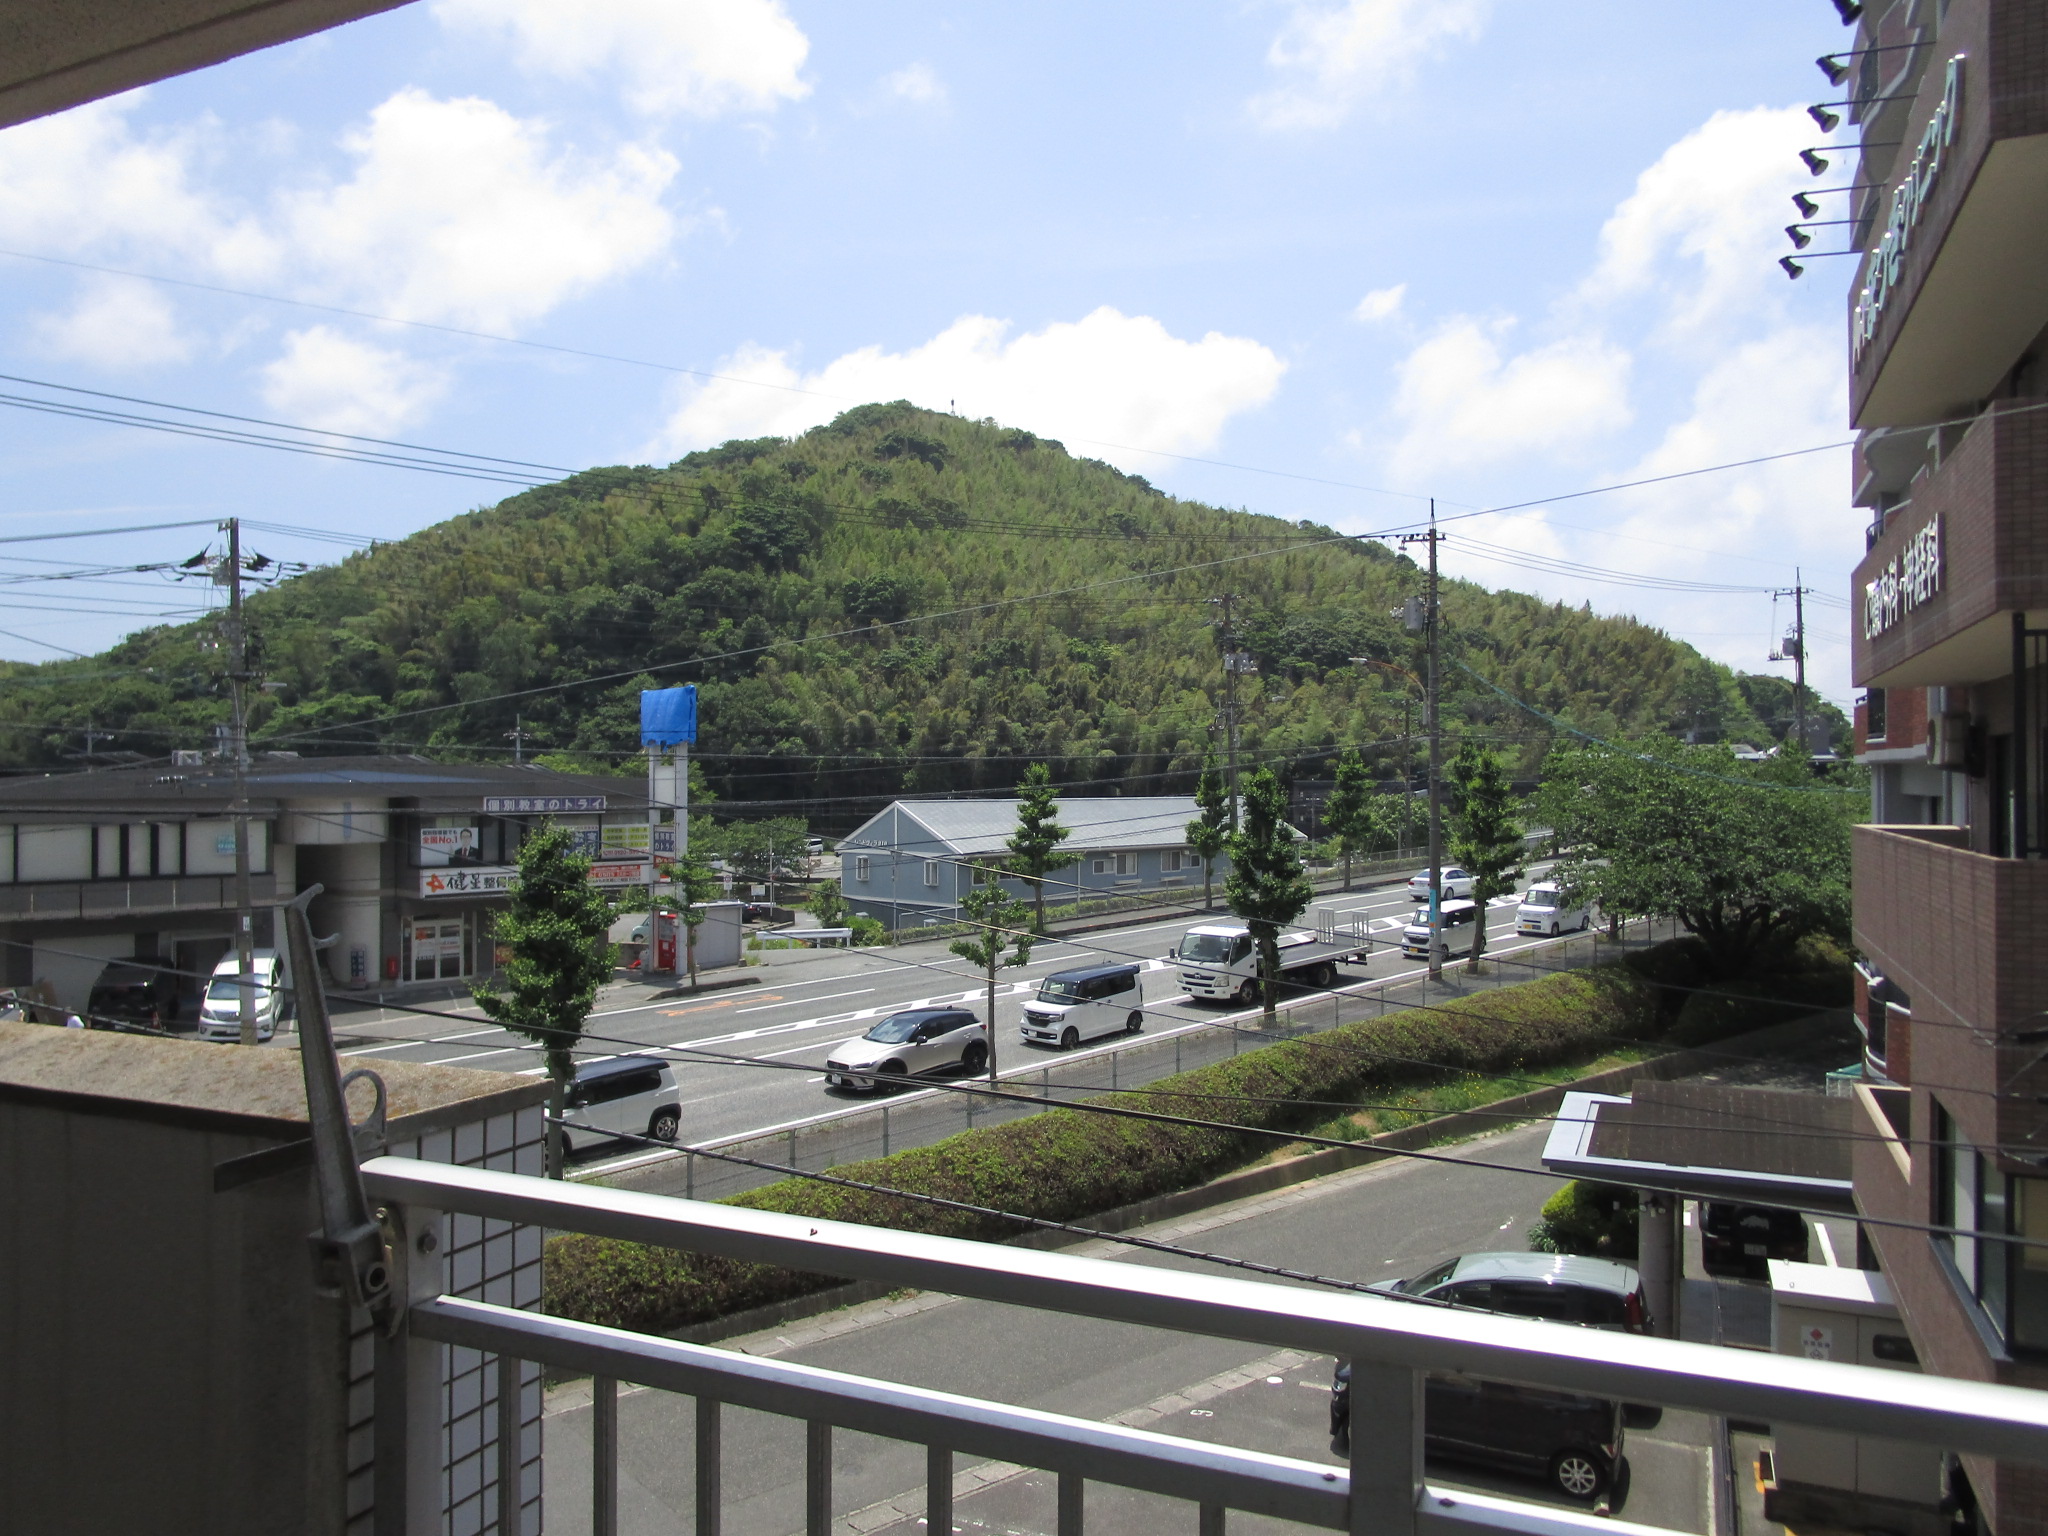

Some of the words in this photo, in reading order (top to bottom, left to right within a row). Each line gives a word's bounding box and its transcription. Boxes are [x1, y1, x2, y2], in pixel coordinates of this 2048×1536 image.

[487, 798, 603, 812] 個別教室のトライ
